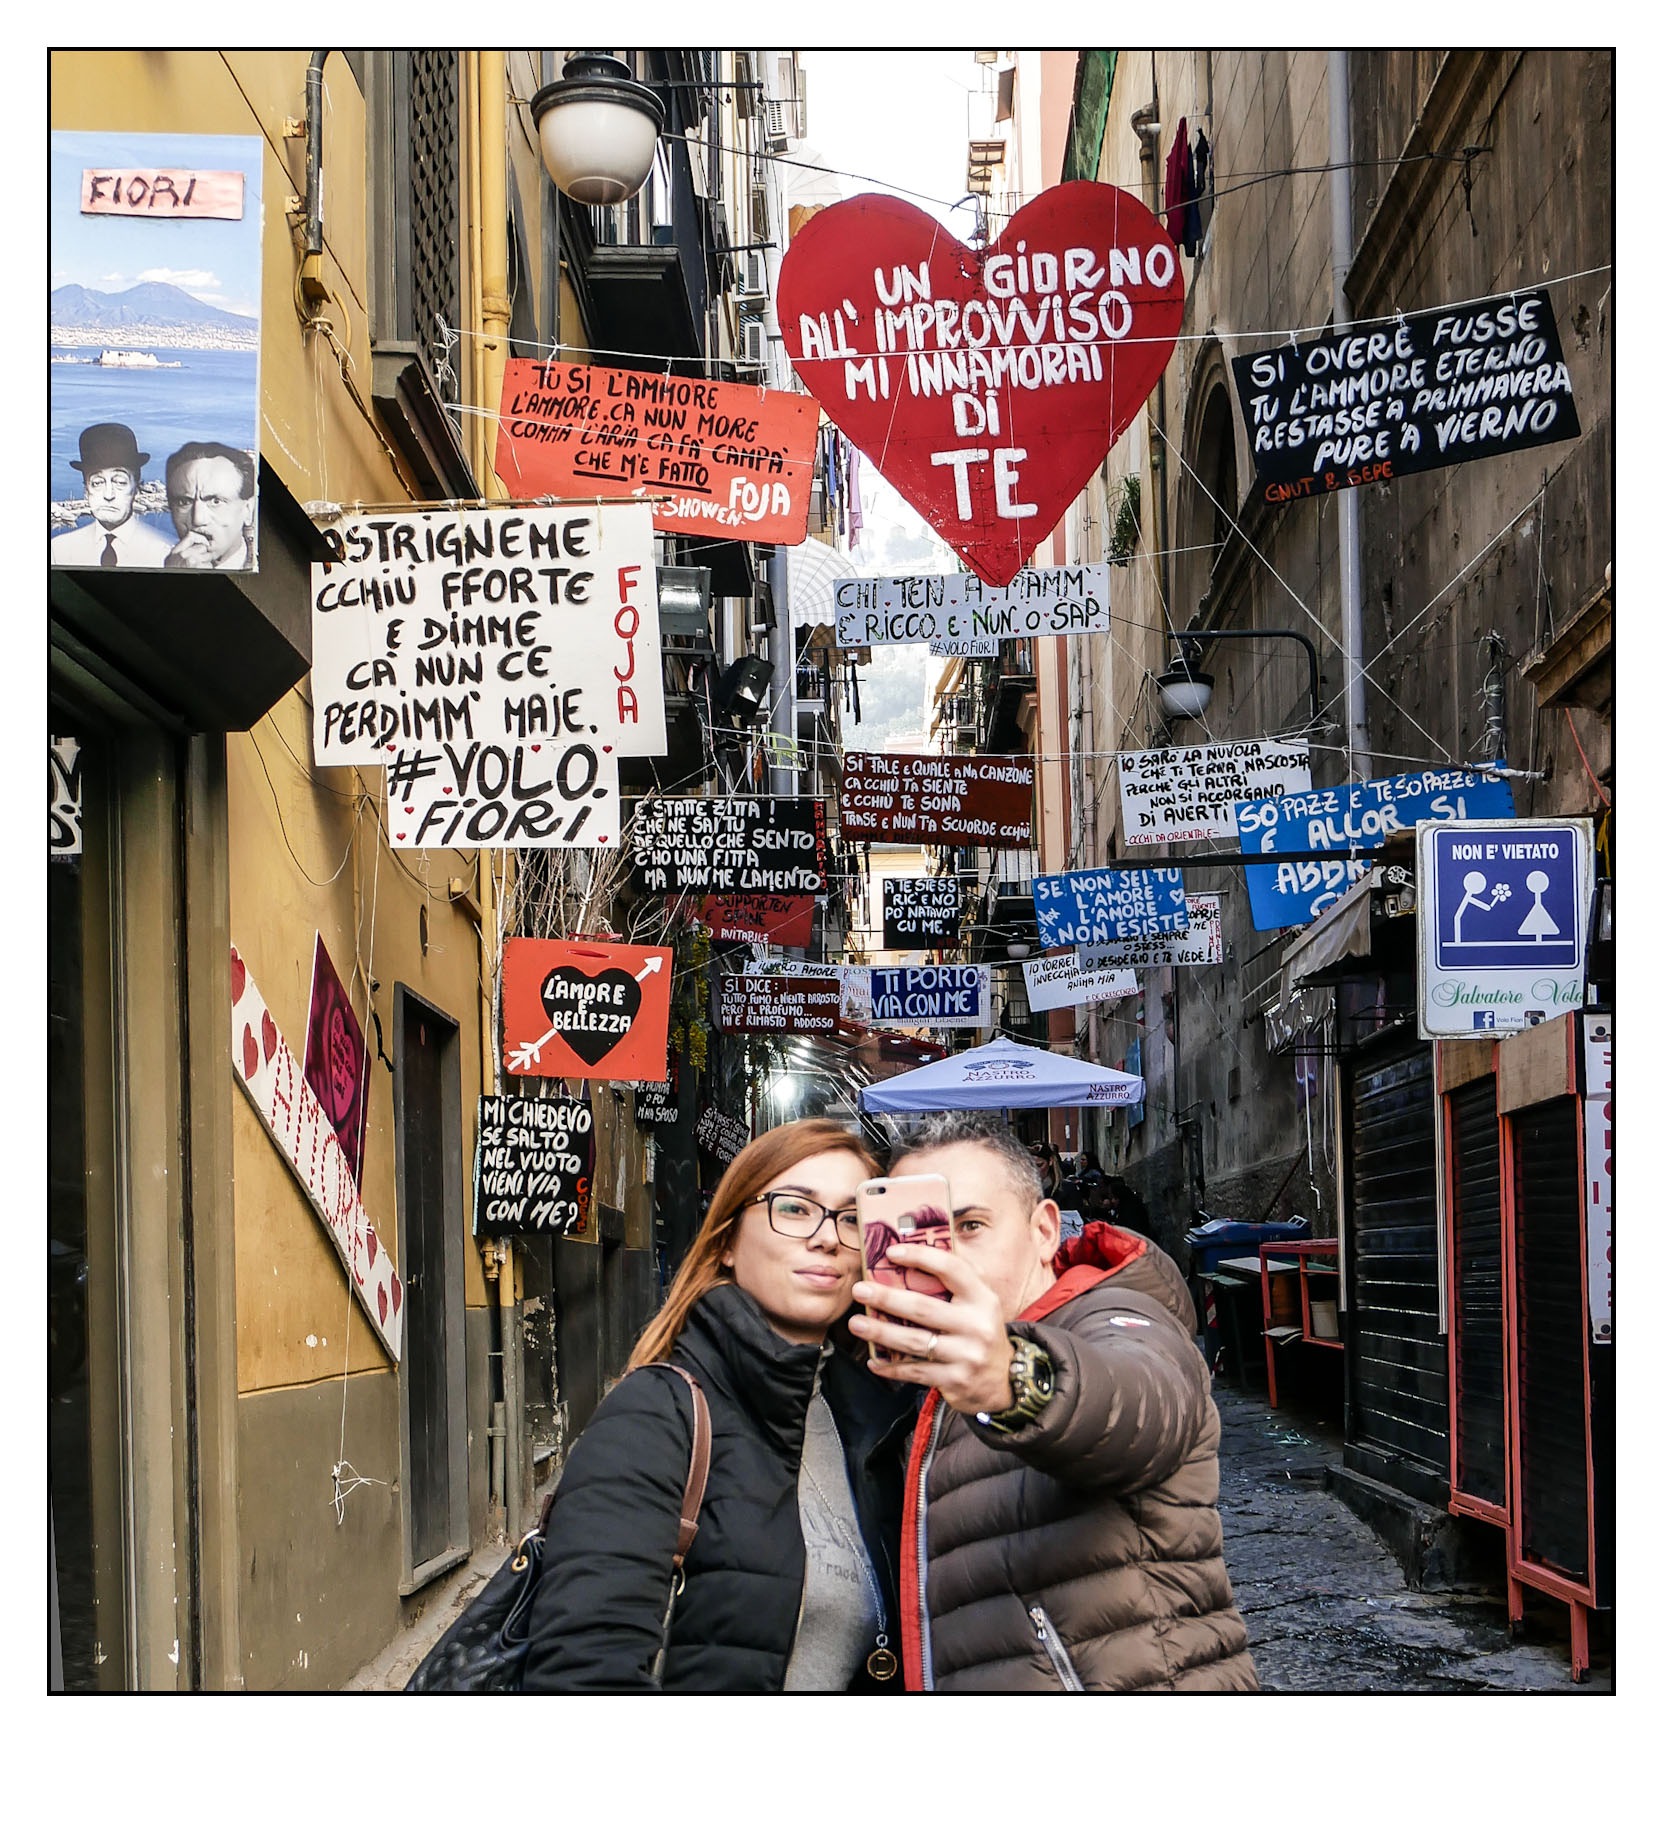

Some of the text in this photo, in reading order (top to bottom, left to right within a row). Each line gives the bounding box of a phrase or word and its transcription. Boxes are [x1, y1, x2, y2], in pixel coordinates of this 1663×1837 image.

[89, 172, 196, 209] FIORI
[874, 240, 1175, 306] UN GIORNO
[800, 291, 1133, 358] ALL' IMPROVVISO
[1251, 300, 1543, 387] SI OVERE FUSSE
[845, 343, 1104, 402] MI INNAMORAI
[1250, 334, 1548, 425] TU L'AMMORE ETERNO
[532, 365, 720, 410] TU SI L'AMMORE
[952, 389, 1001, 437] DI
[1255, 361, 1573, 452] RESTASSE PRIMMAVERA
[610, 402, 636, 423] CA
[644, 409, 687, 432] NUN
[698, 413, 760, 442] MORE
[1313, 398, 1559, 473] PURE VIERNO
[574, 449, 710, 486] CHE FATTO
[1265, 461, 1394, 502] GNUT SEPE
[729, 476, 791, 521] FOJA
[930, 447, 1039, 522] TE
[441, 566, 595, 610] FFORTE
[837, 574, 983, 609] CHI TEN A
[386, 611, 542, 650] E DIMME
[866, 609, 937, 641] RICCO
[973, 604, 1017, 637] NUN
[1025, 609, 1040, 630] O
[1050, 597, 1101, 630] SAP
[613, 565, 642, 725] FOJA
[415, 645, 552, 688] NUN CE
[846, 754, 1034, 785] SI TALE QUALE NA CANZONE
[1121, 743, 1261, 772] IO LA NUVOLA
[1141, 753, 1311, 779] CHE TI NASCOSTA
[845, 777, 968, 796] CA SIENTE
[1177, 771, 1249, 790] GLI ALTRI
[653, 799, 760, 819] STATTE ZITTA
[901, 795, 962, 812] TE SONA
[1149, 784, 1285, 809] NON SI ACCORGANO
[1431, 795, 1467, 821] SI
[415, 799, 593, 846] FIORI
[633, 816, 745, 835] CHE NE SAI TU
[842, 810, 997, 836] TRASE NUN SCUORDE
[1138, 802, 1229, 828] DI AVERTI
[655, 828, 815, 850] QUELLO CHE SENTO
[1156, 832, 1166, 843] DA
[1452, 843, 1560, 860] NON E' VIETATO
[674, 849, 708, 866] UNA
[713, 849, 760, 868] FITTA
[644, 865, 822, 891] MA NUN ME LAMENTO
[899, 879, 957, 893] TE STESS
[1037, 867, 1179, 900] SE NON SEI TU
[932, 893, 955, 906] NO
[1079, 901, 1158, 925] L'AMORE
[721, 926, 769, 944] AVITABILE
[897, 919, 916, 933] CU
[1057, 911, 1189, 944] NON ESISTE
[802, 965, 838, 977] AMORE
[1041, 954, 1076, 972] VORREI
[543, 974, 626, 1006] L'AMORE
[876, 969, 900, 994] TI
[906, 966, 978, 991] PORTO
[1067, 971, 1116, 991] ANIMA MIA
[1431, 978, 1582, 1007] Salvatore Volo
[721, 993, 771, 1004] TUTTO FUMO
[872, 994, 903, 1019] VIA
[905, 992, 940, 1016] CON
[944, 990, 971, 1014] ME
[553, 1009, 632, 1034] BELLEZZA
[746, 1015, 834, 1028] RIMASTO ADDOSSO
[962, 1074, 1036, 1082] AZZURRO
[1089, 1084, 1127, 1093] NASTRO
[1086, 1092, 1130, 1101] AZZURRO
[484, 1095, 592, 1134] MI CHIEDEVO
[482, 1126, 569, 1151] SE SALTO
[483, 1147, 581, 1174] NEL VUOTO
[483, 1169, 561, 1198] VIENI VIA
[486, 1197, 529, 1221] CON
[530, 1200, 578, 1235] ME?
